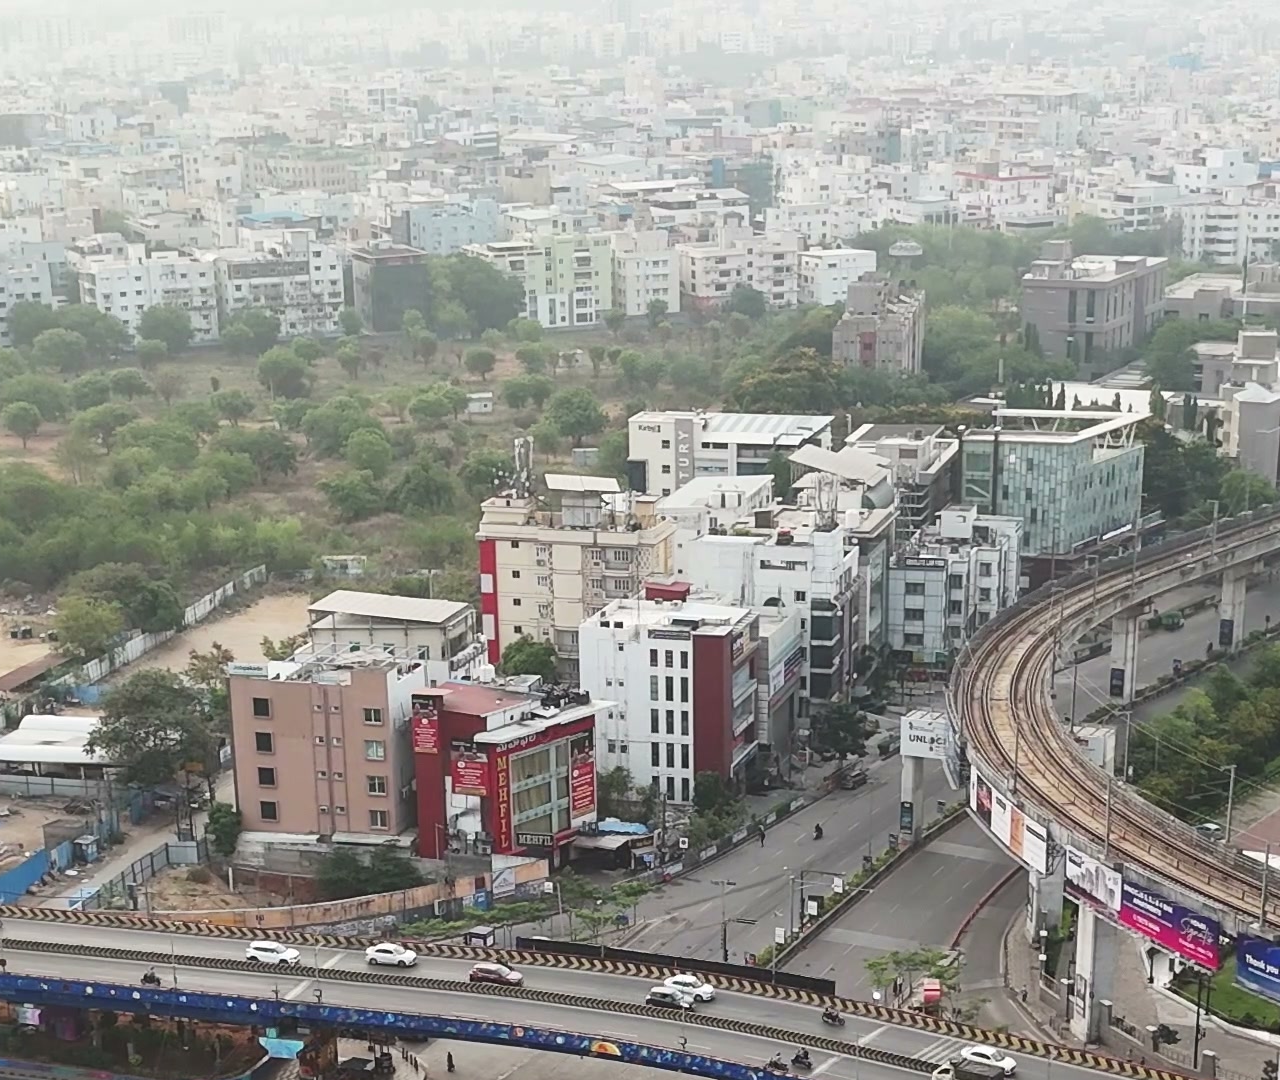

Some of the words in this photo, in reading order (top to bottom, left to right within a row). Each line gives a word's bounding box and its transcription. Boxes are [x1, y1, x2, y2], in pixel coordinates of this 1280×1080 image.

[678, 431, 690, 488] TURY
[496, 755, 509, 849] MEHFIL
[518, 833, 553, 846] MEHFIL
